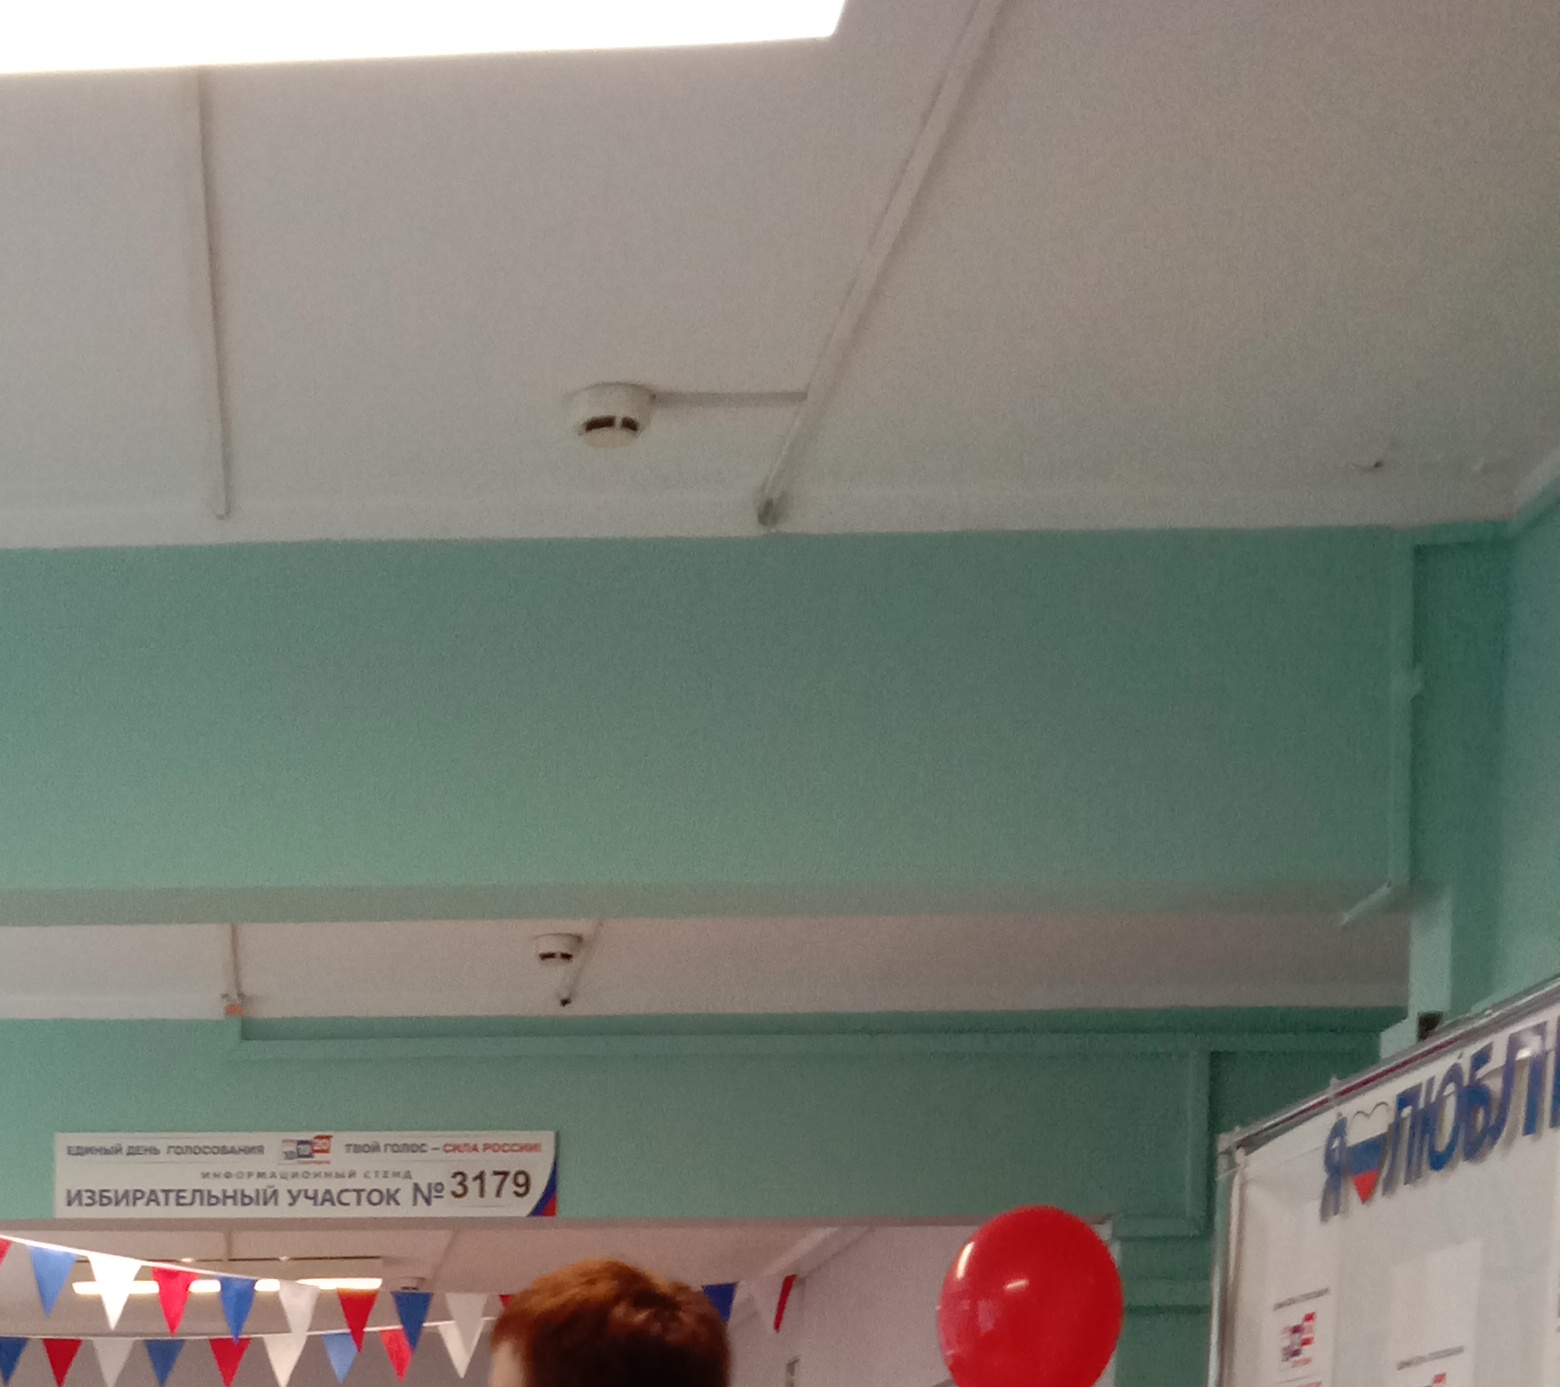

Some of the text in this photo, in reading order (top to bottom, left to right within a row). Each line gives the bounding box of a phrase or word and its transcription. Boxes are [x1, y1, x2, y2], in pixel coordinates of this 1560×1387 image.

[67, 1143, 265, 1156] ЕДИНЫЙ ДЕНЬ ГОЛОСОВАНИЯ
[345, 1141, 380, 1153] ТВОЙ
[384, 1143, 428, 1153] ГОЛОС
[442, 1142, 479, 1153] СИЛА
[201, 1169, 413, 1180] ИНФОРМАЦИОННЫЙ СТЕНД
[1319, 1117, 1348, 1223] Я
[66, 1185, 279, 1207] ИЗБИРАТЕЛЬНЫЙ
[287, 1187, 401, 1207] УЧАСТОК
[450, 1169, 532, 1199] 3179
